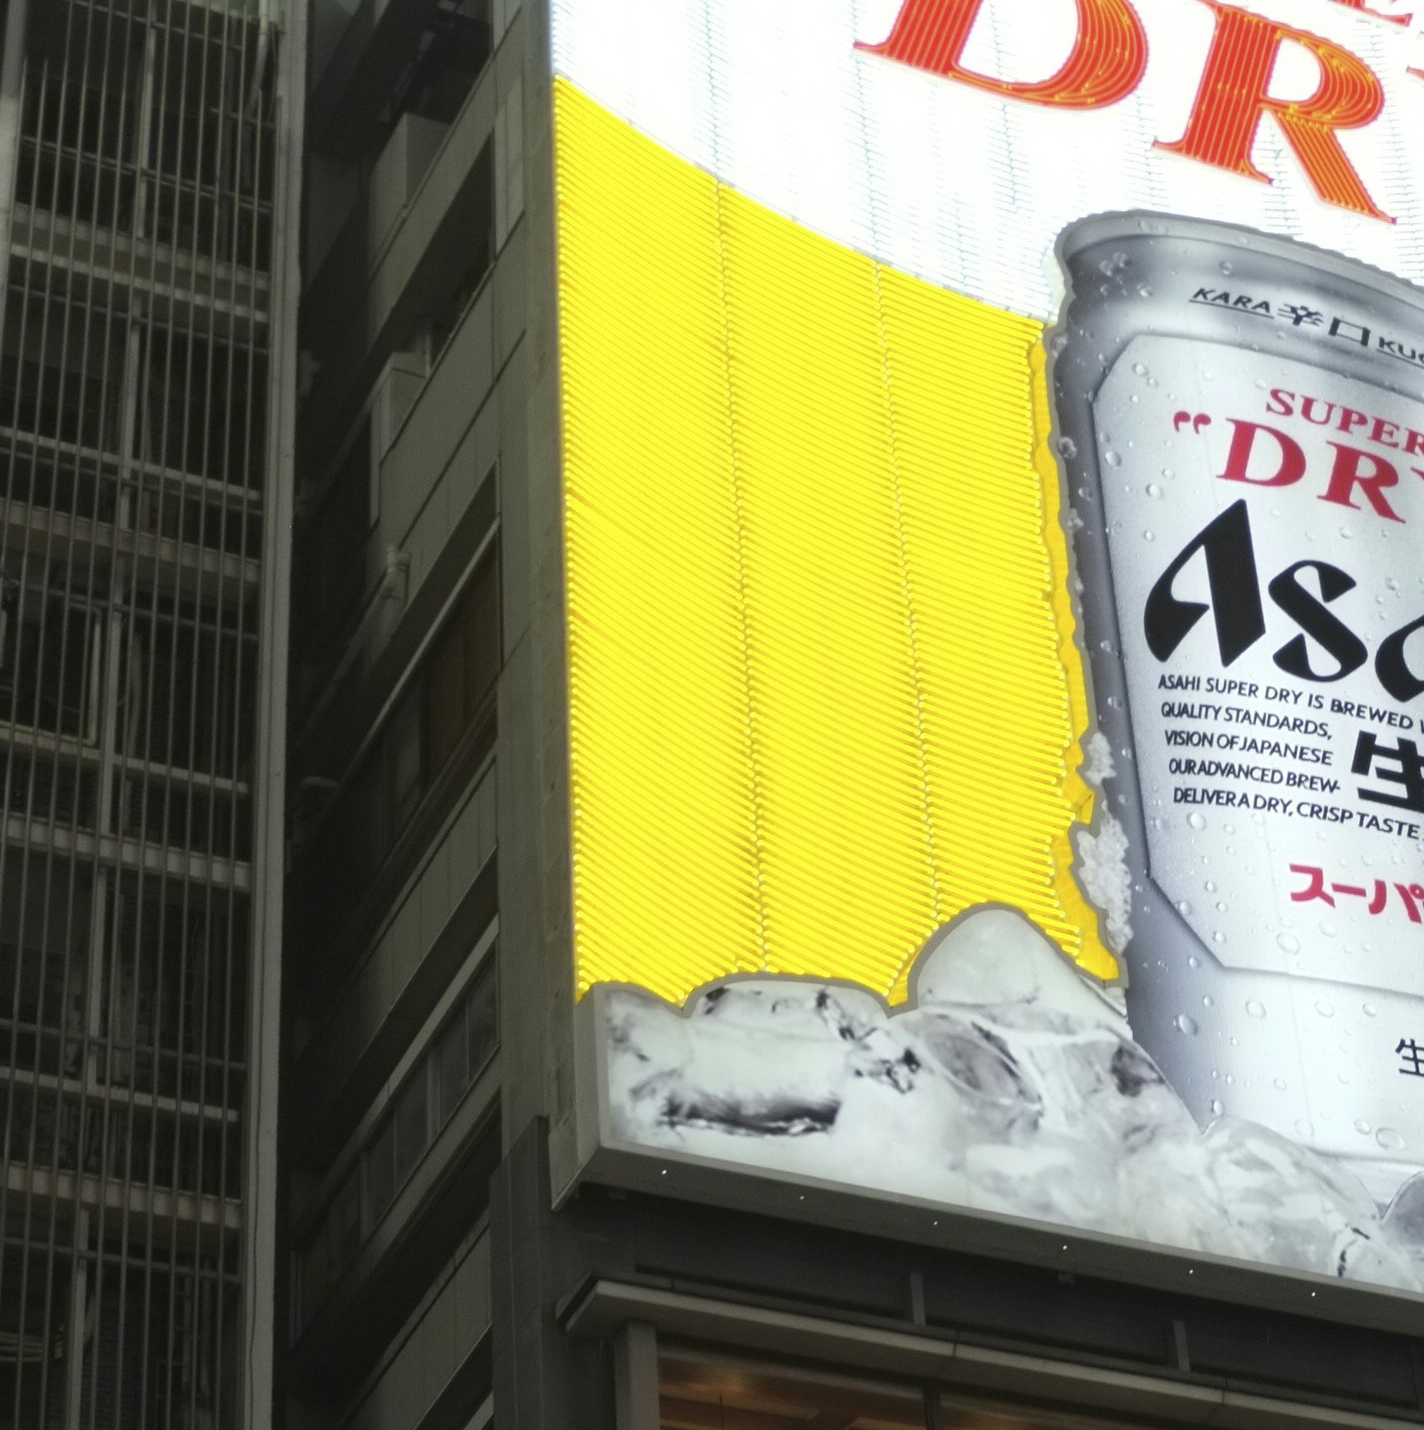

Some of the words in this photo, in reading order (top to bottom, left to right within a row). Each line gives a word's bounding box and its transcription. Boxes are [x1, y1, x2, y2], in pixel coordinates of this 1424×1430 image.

[1193, 287, 1271, 314] KARA
[1158, 674, 1201, 691] ASAHI
[1206, 678, 1259, 698] SUPER
[1265, 686, 1303, 705] DRY
[1308, 693, 1324, 709] IS
[1330, 698, 1415, 730] BREWED
[1161, 701, 1223, 721] QUALITY
[1224, 707, 1332, 740] STANDARDS,
[1164, 730, 1214, 748] VISION
[1217, 734, 1240, 750] OF
[1239, 737, 1333, 766] JAPANESE
[1169, 758, 1196, 775] OUR
[1196, 760, 1284, 784] ADVANCED
[1173, 787, 1236, 807] DELIVER
[1237, 793, 1251, 808] A
[1253, 794, 1293, 816] DRY,
[1296, 801, 1353, 824] CRISP
[1356, 812, 1419, 839] TASTE
